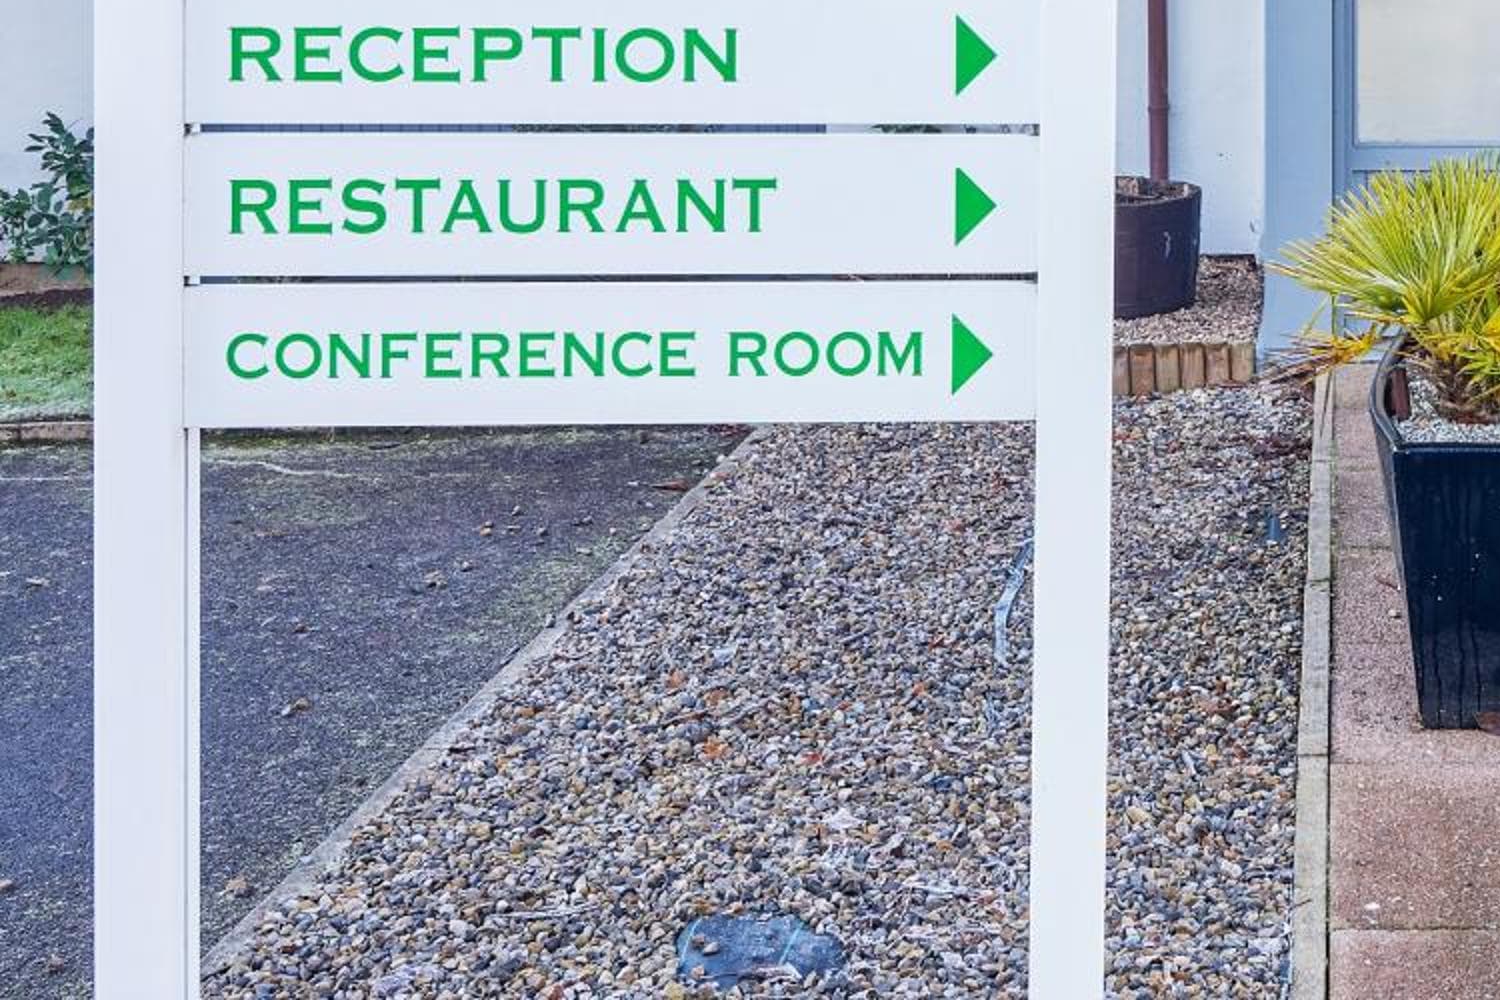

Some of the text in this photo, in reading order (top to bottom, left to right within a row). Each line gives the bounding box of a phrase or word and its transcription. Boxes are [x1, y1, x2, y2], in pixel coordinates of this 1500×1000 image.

[230, 26, 738, 83] RECEPTION
[230, 178, 777, 234] RESTAURANT
[226, 330, 923, 380] CONFERENCE ROOM
